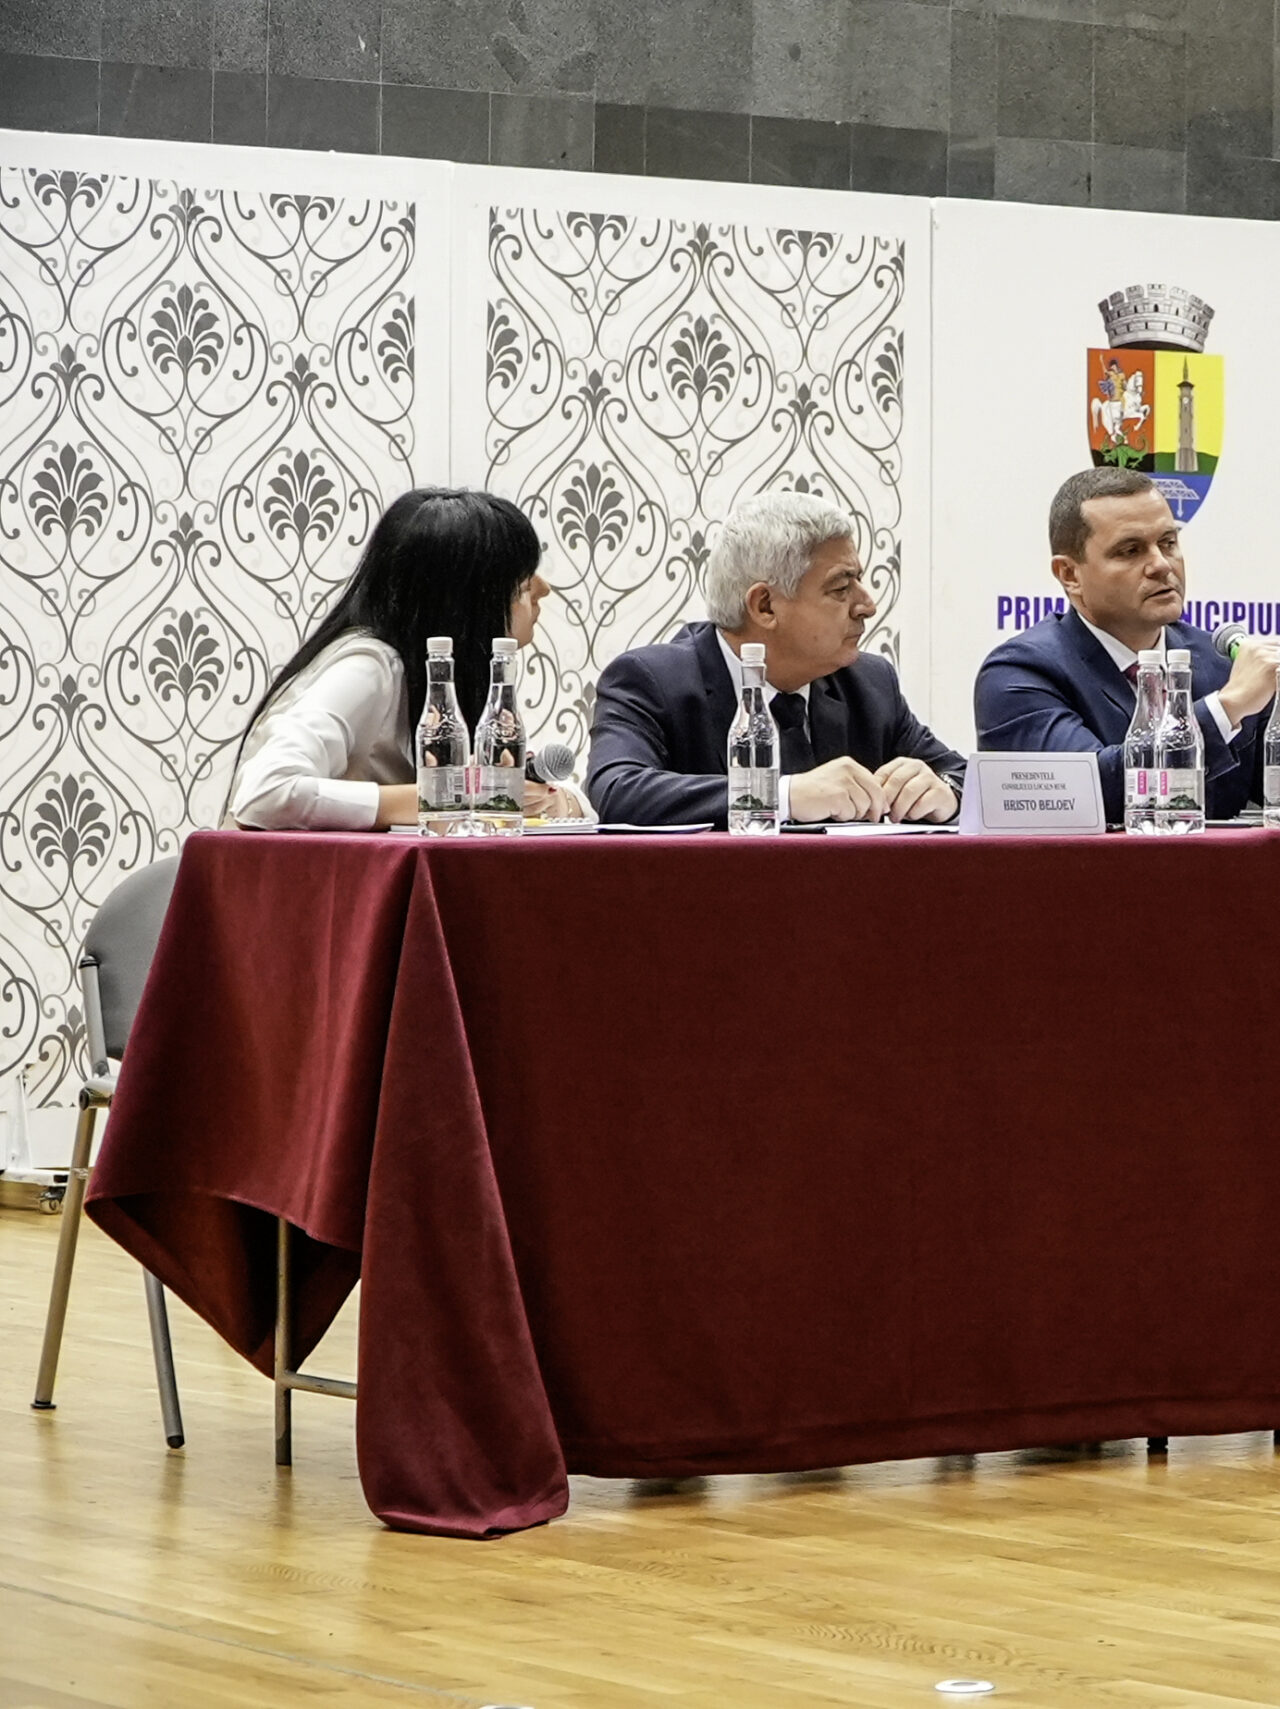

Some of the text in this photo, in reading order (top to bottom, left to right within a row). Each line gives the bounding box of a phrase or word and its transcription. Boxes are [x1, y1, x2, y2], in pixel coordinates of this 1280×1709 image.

[998, 595, 1064, 630] PRIM
[1003, 798, 1075, 811] HRISTO BELOEV
